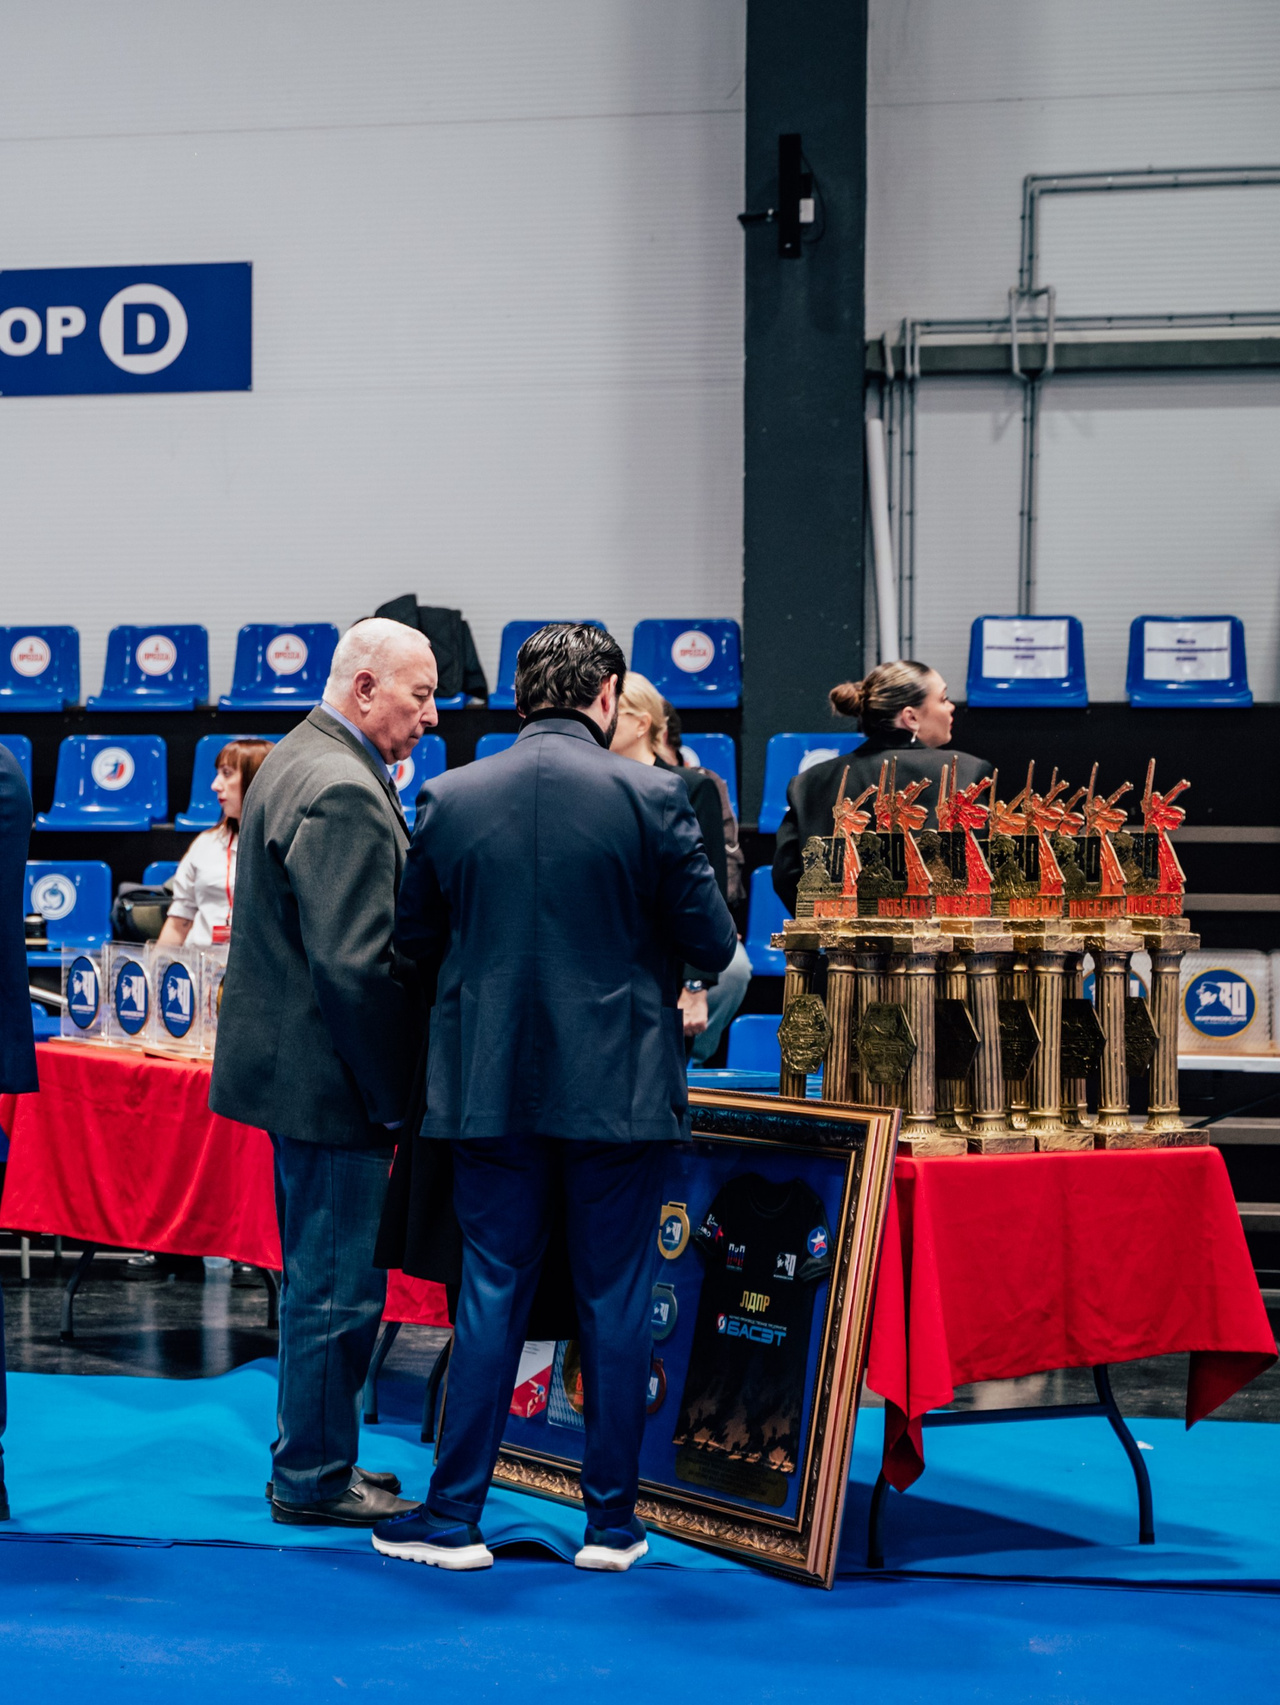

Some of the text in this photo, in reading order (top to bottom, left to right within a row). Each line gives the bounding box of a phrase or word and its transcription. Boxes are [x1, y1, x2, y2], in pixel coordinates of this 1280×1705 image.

[122, 302, 171, 356] D
[740, 1290, 770, 1313] ЛДПР
[726, 1320, 787, 1347] БАСЭТ
